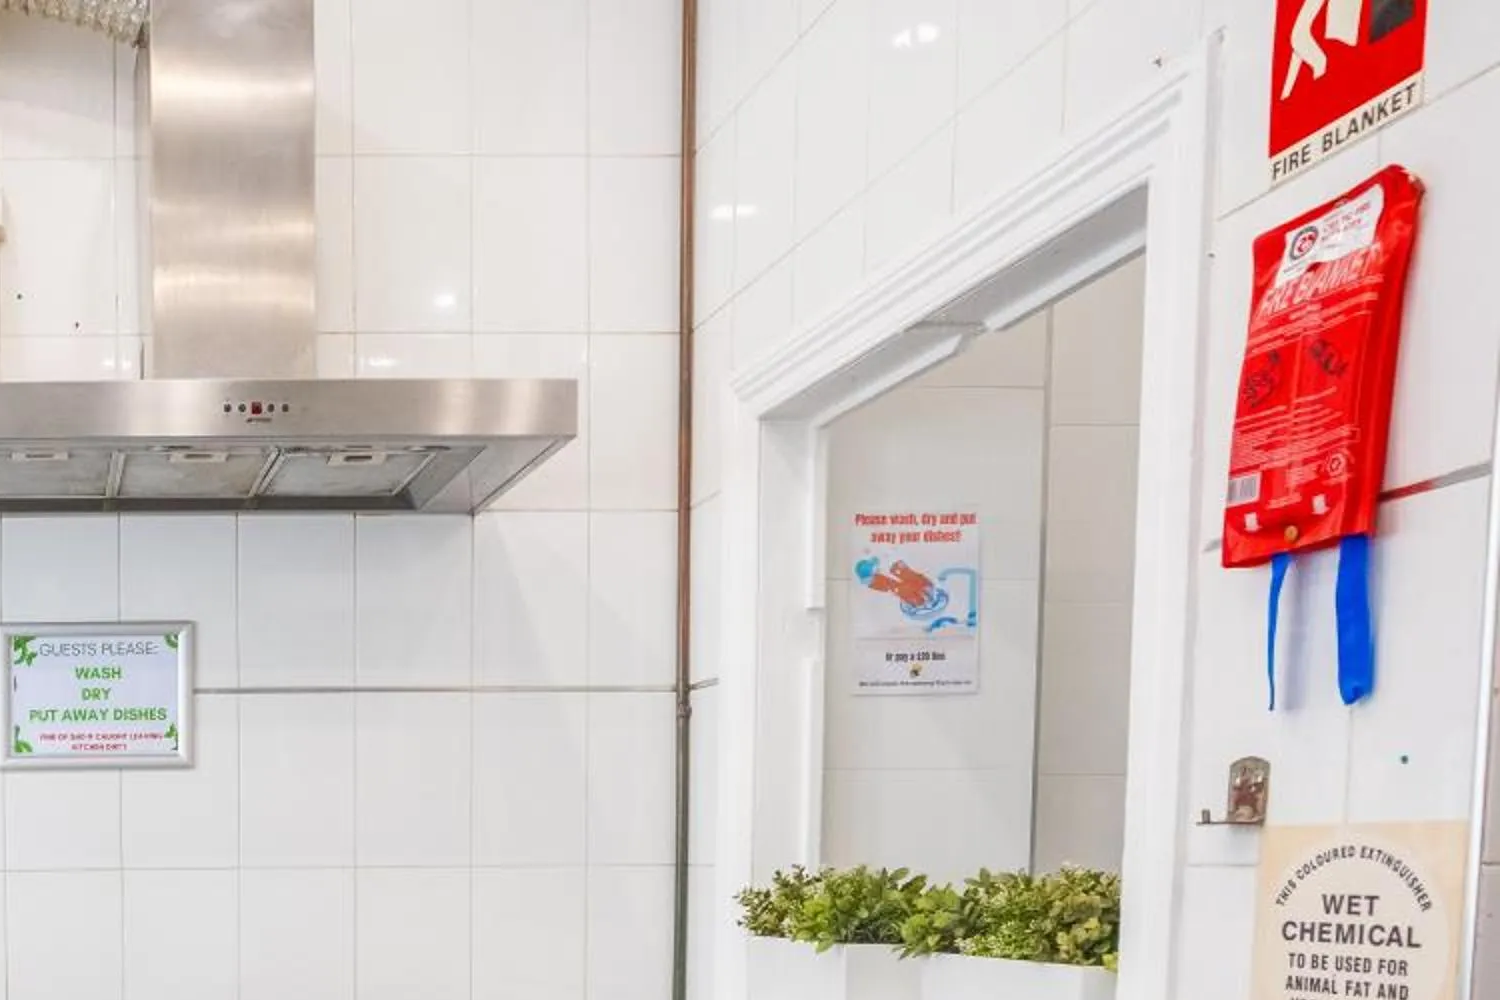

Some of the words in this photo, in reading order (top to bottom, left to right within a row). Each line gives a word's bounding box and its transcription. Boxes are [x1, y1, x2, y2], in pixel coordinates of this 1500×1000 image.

[1271, 144, 1312, 181] FIRE
[1322, 82, 1417, 153] BLANKET
[855, 513, 886, 526] Please
[889, 513, 918, 526] wash,
[921, 512, 937, 526] dry
[940, 512, 957, 525] and
[960, 512, 976, 526] put
[871, 532, 896, 544] away
[899, 532, 921, 544] your
[39, 642, 97, 656] GUESTS
[75, 667, 122, 680] WASH
[82, 688, 111, 701] DRY
[29, 709, 57, 721] PUT
[62, 708, 109, 721] AWAY
[113, 707, 167, 721] DISHES
[1276, 879, 1296, 906] THIS
[1296, 845, 1355, 881] COLOURED
[1360, 845, 1433, 912] EXTINGUISHER
[1321, 893, 1380, 916] WET
[1281, 920, 1422, 949] CHEMICAL
[1288, 952, 1305, 969] TO
[1311, 954, 1329, 971] BE
[1335, 955, 1372, 974] USED
[1377, 959, 1409, 976] FOR
[1285, 975, 1338, 995] ANIMAL
[1345, 980, 1372, 998] FAT
[1377, 983, 1409, 1000] AND
